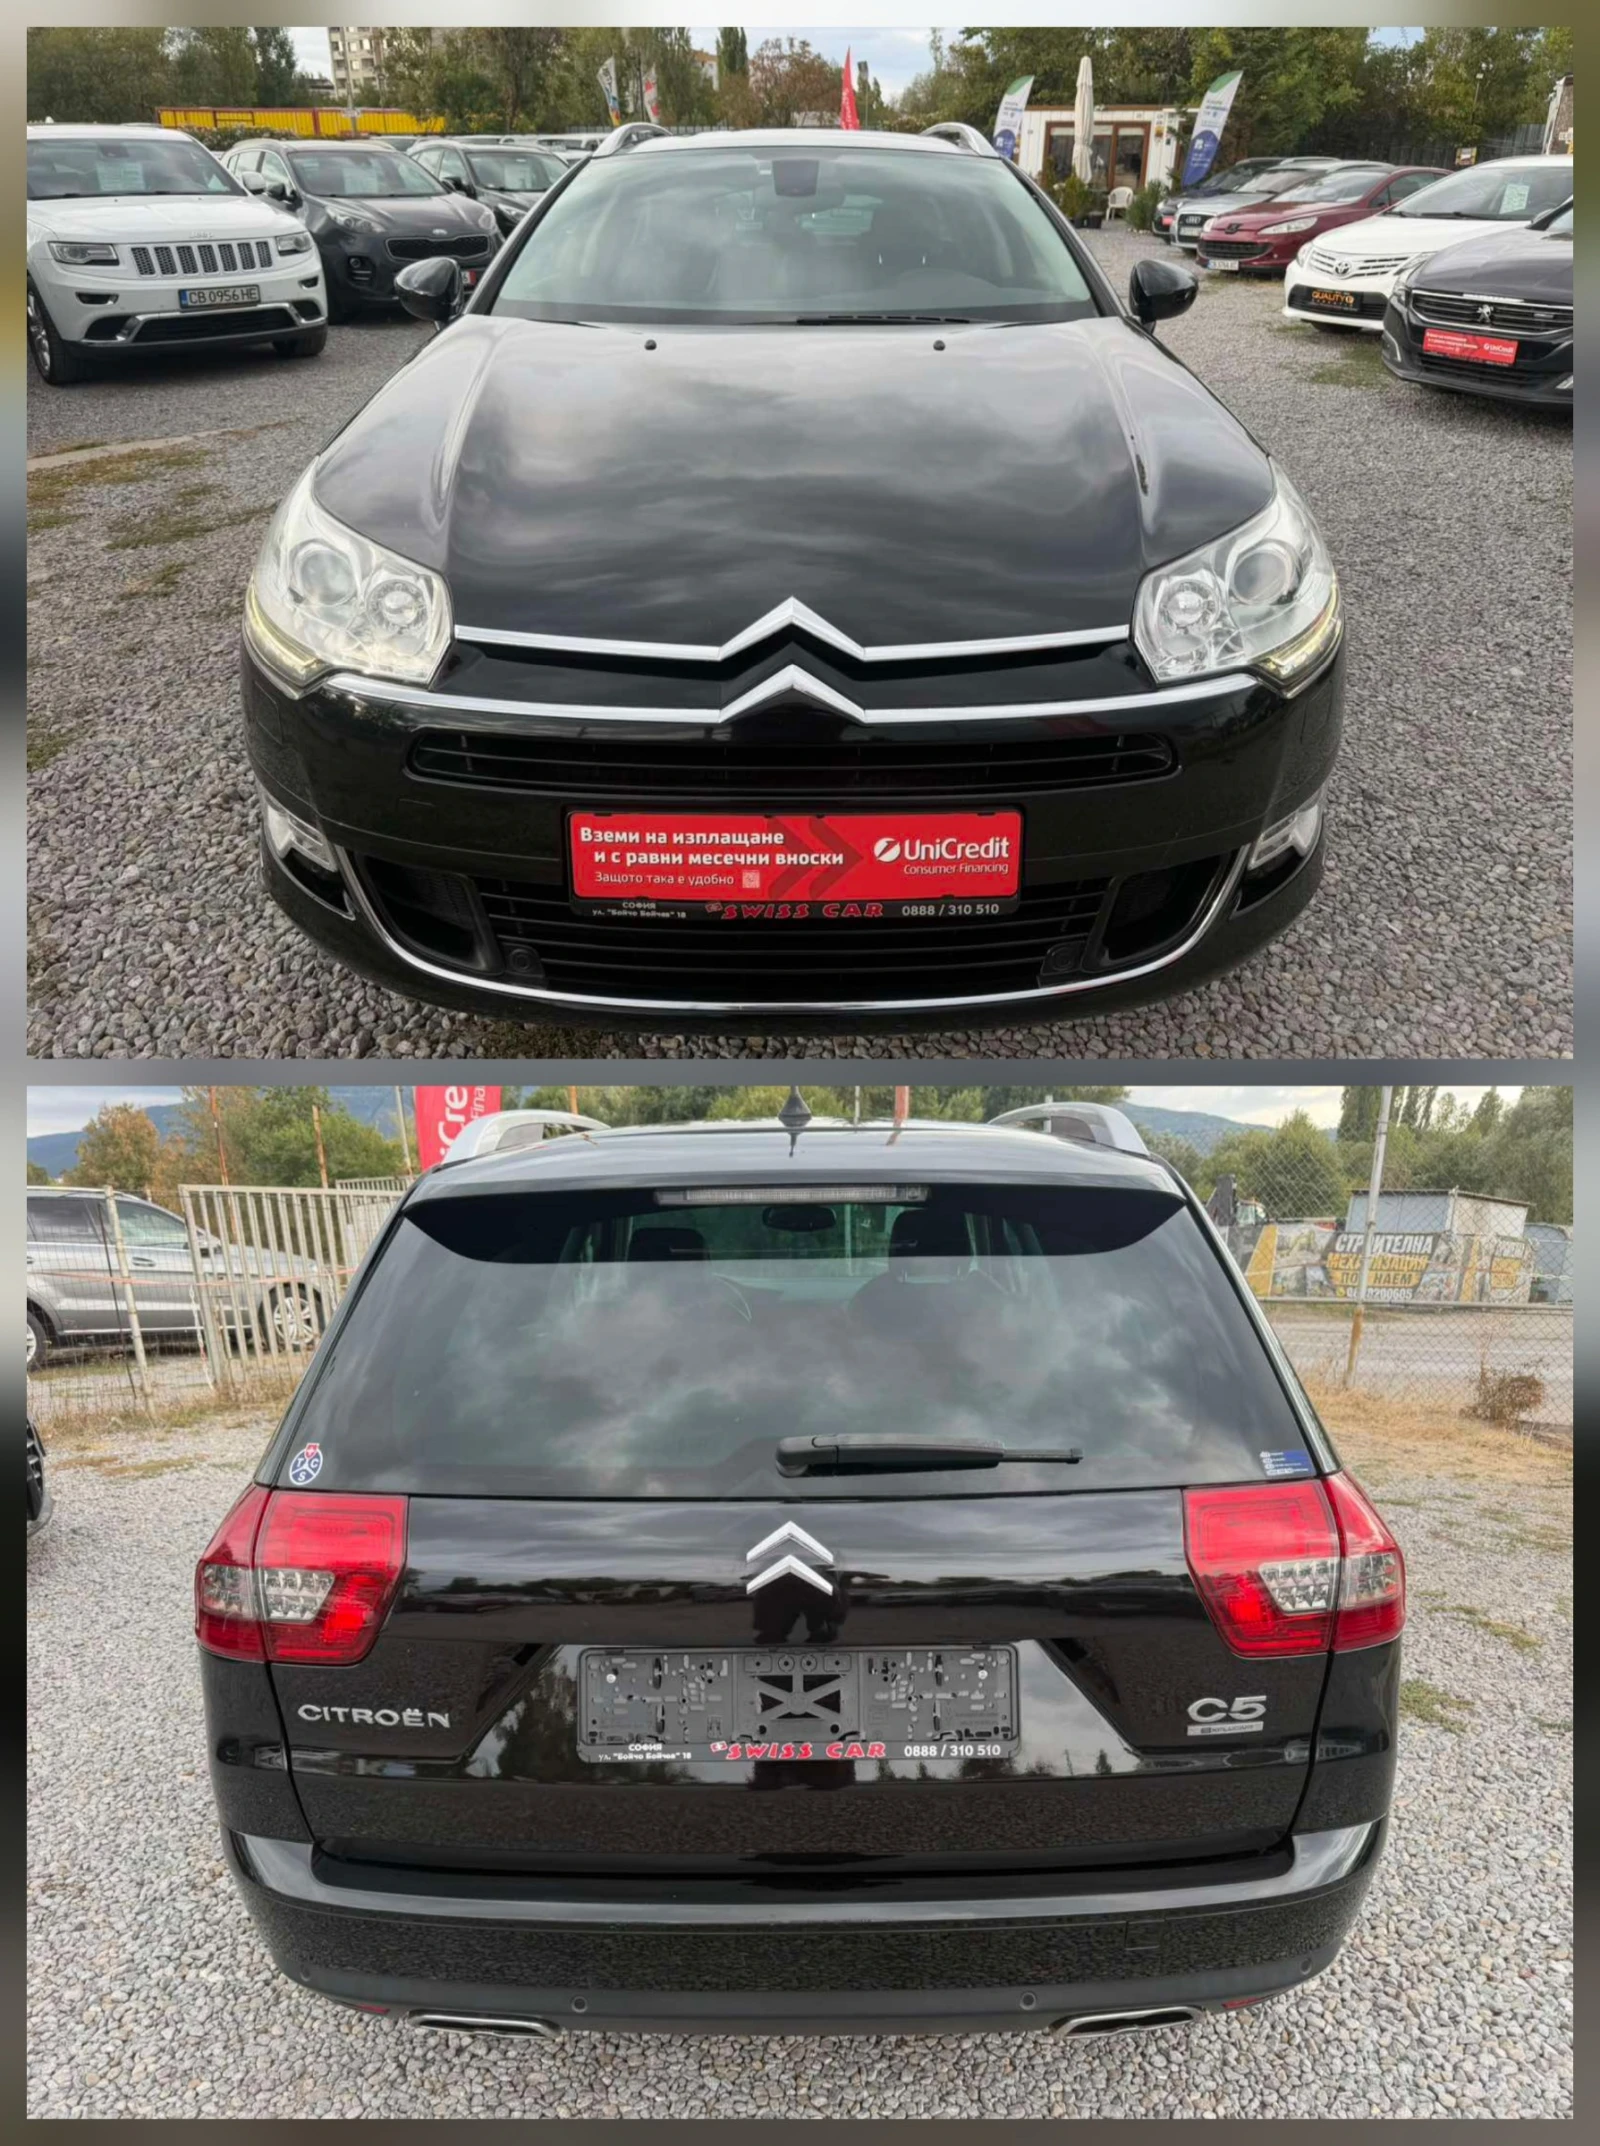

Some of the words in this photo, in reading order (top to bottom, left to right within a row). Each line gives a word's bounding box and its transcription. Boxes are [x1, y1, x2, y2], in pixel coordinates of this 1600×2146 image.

[208, 289, 240, 302] 0956
[580, 827, 640, 844] Вземи
[645, 831, 668, 844] на
[672, 831, 785, 847] изплащане
[904, 836, 1010, 860] UniCredit
[594, 851, 606, 863] и
[611, 852, 621, 863] с
[626, 852, 683, 867] равни
[688, 852, 770, 865] месечни
[775, 852, 844, 865] вноски
[904, 864, 956, 875] Consumer
[959, 863, 1009, 875] Financing
[594, 871, 643, 885] Защото
[646, 873, 675, 884] така
[678, 874, 685, 884] е
[689, 873, 734, 887] удобно
[622, 901, 656, 909] СОФИЯ
[721, 903, 810, 919] SWISS
[822, 903, 883, 918] CAR
[902, 905, 935, 916] 0888
[939, 904, 946, 916] /
[948, 904, 972, 915] 310
[975, 903, 999, 914] 510
[1335, 1234, 1434, 1254] СТРИТЕЛНА
[298, 1704, 450, 1728] CITROËN
[1187, 1695, 1267, 1722] C5
[628, 1743, 663, 1751] СОФИЯ
[725, 1742, 813, 1760] SWISS
[825, 1742, 886, 1758] CAR
[904, 1745, 937, 1757] 0888
[940, 1744, 947, 1757] /
[950, 1745, 974, 1756] 310
[977, 1744, 1001, 1756] 510
[683, 1752, 692, 1760] 18
